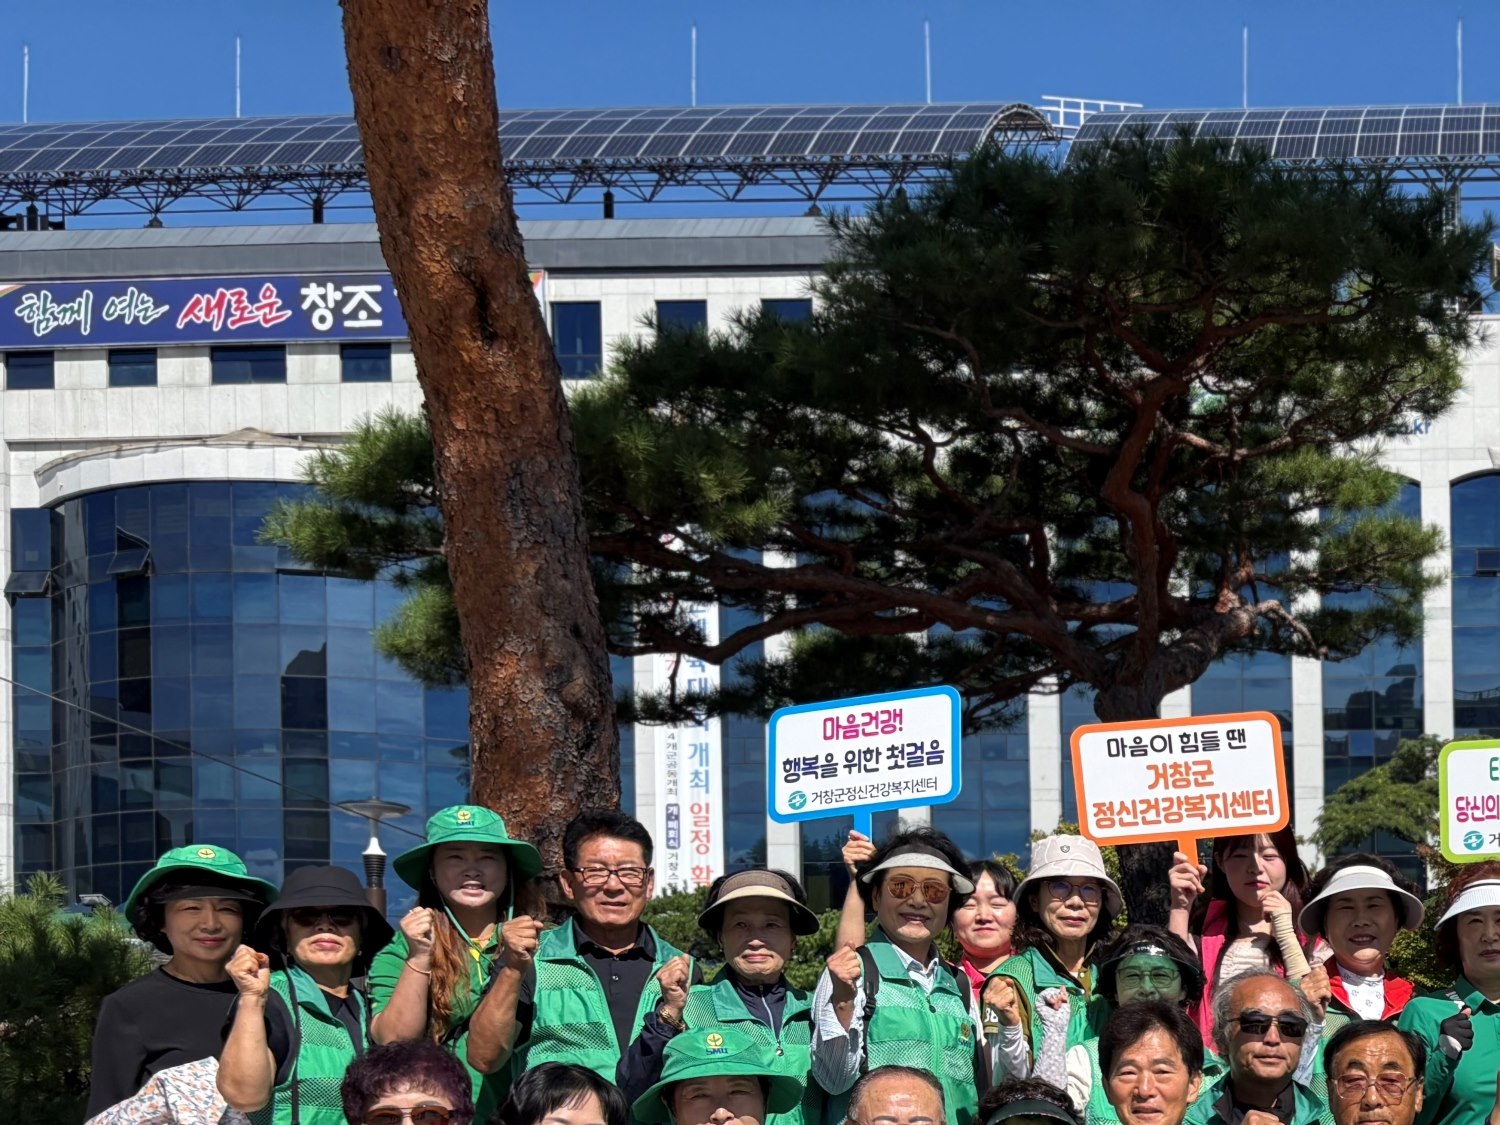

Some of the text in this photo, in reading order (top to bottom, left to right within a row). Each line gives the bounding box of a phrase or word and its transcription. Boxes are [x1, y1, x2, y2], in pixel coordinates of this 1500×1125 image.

[15, 282, 383, 337] 함께 여는 새로운 창조
[823, 708, 904, 741] 마음건강!
[1106, 728, 1248, 758] 마음이 힘들 땐
[687, 742, 710, 795] 개최
[782, 739, 945, 783] 행복을 위한 첫걸음
[1146, 759, 1215, 790] 거창군
[811, 776, 938, 805] 거창군정신건강복지센터
[1092, 788, 1275, 829] 정신건강복지센터
[1455, 794, 1500, 823] 당신의
[690, 802, 711, 855] 일정
